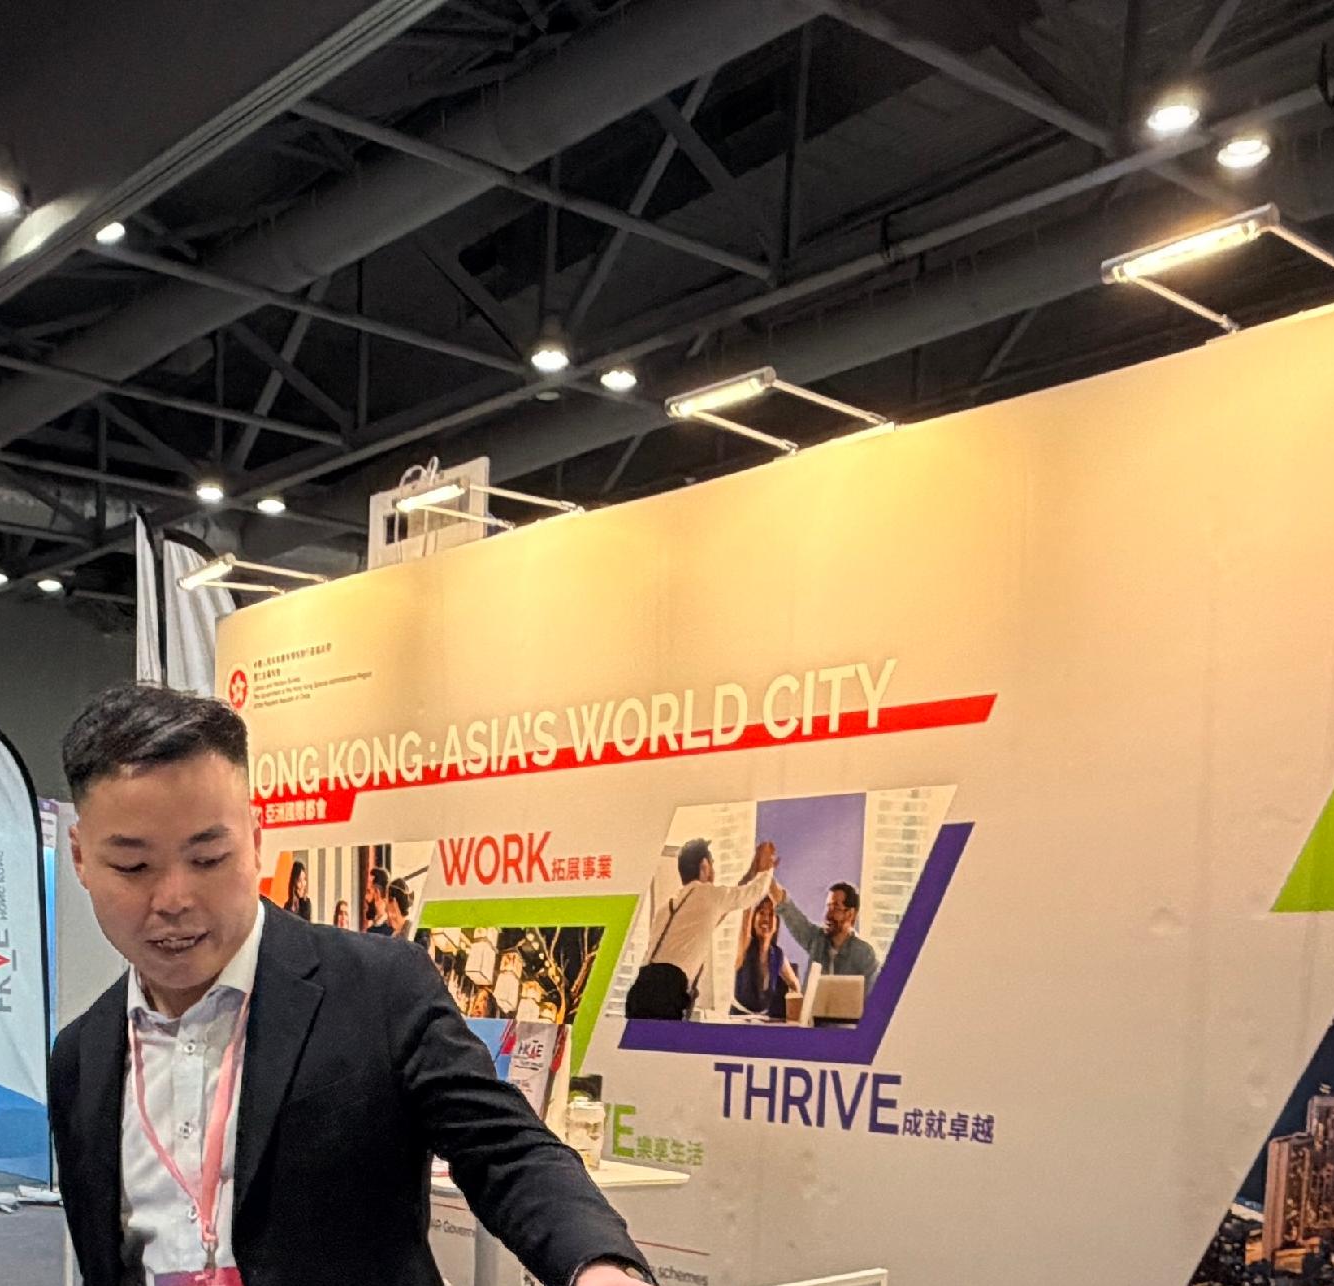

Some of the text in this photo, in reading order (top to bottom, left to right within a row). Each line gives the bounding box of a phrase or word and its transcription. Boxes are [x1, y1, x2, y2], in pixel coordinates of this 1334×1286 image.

[564, 684, 749, 762] WORLD
[763, 658, 898, 741] CITY
[438, 831, 553, 886] WORK
[714, 1062, 903, 1135] THRIVE
[902, 1107, 995, 1144] 成就卓越
